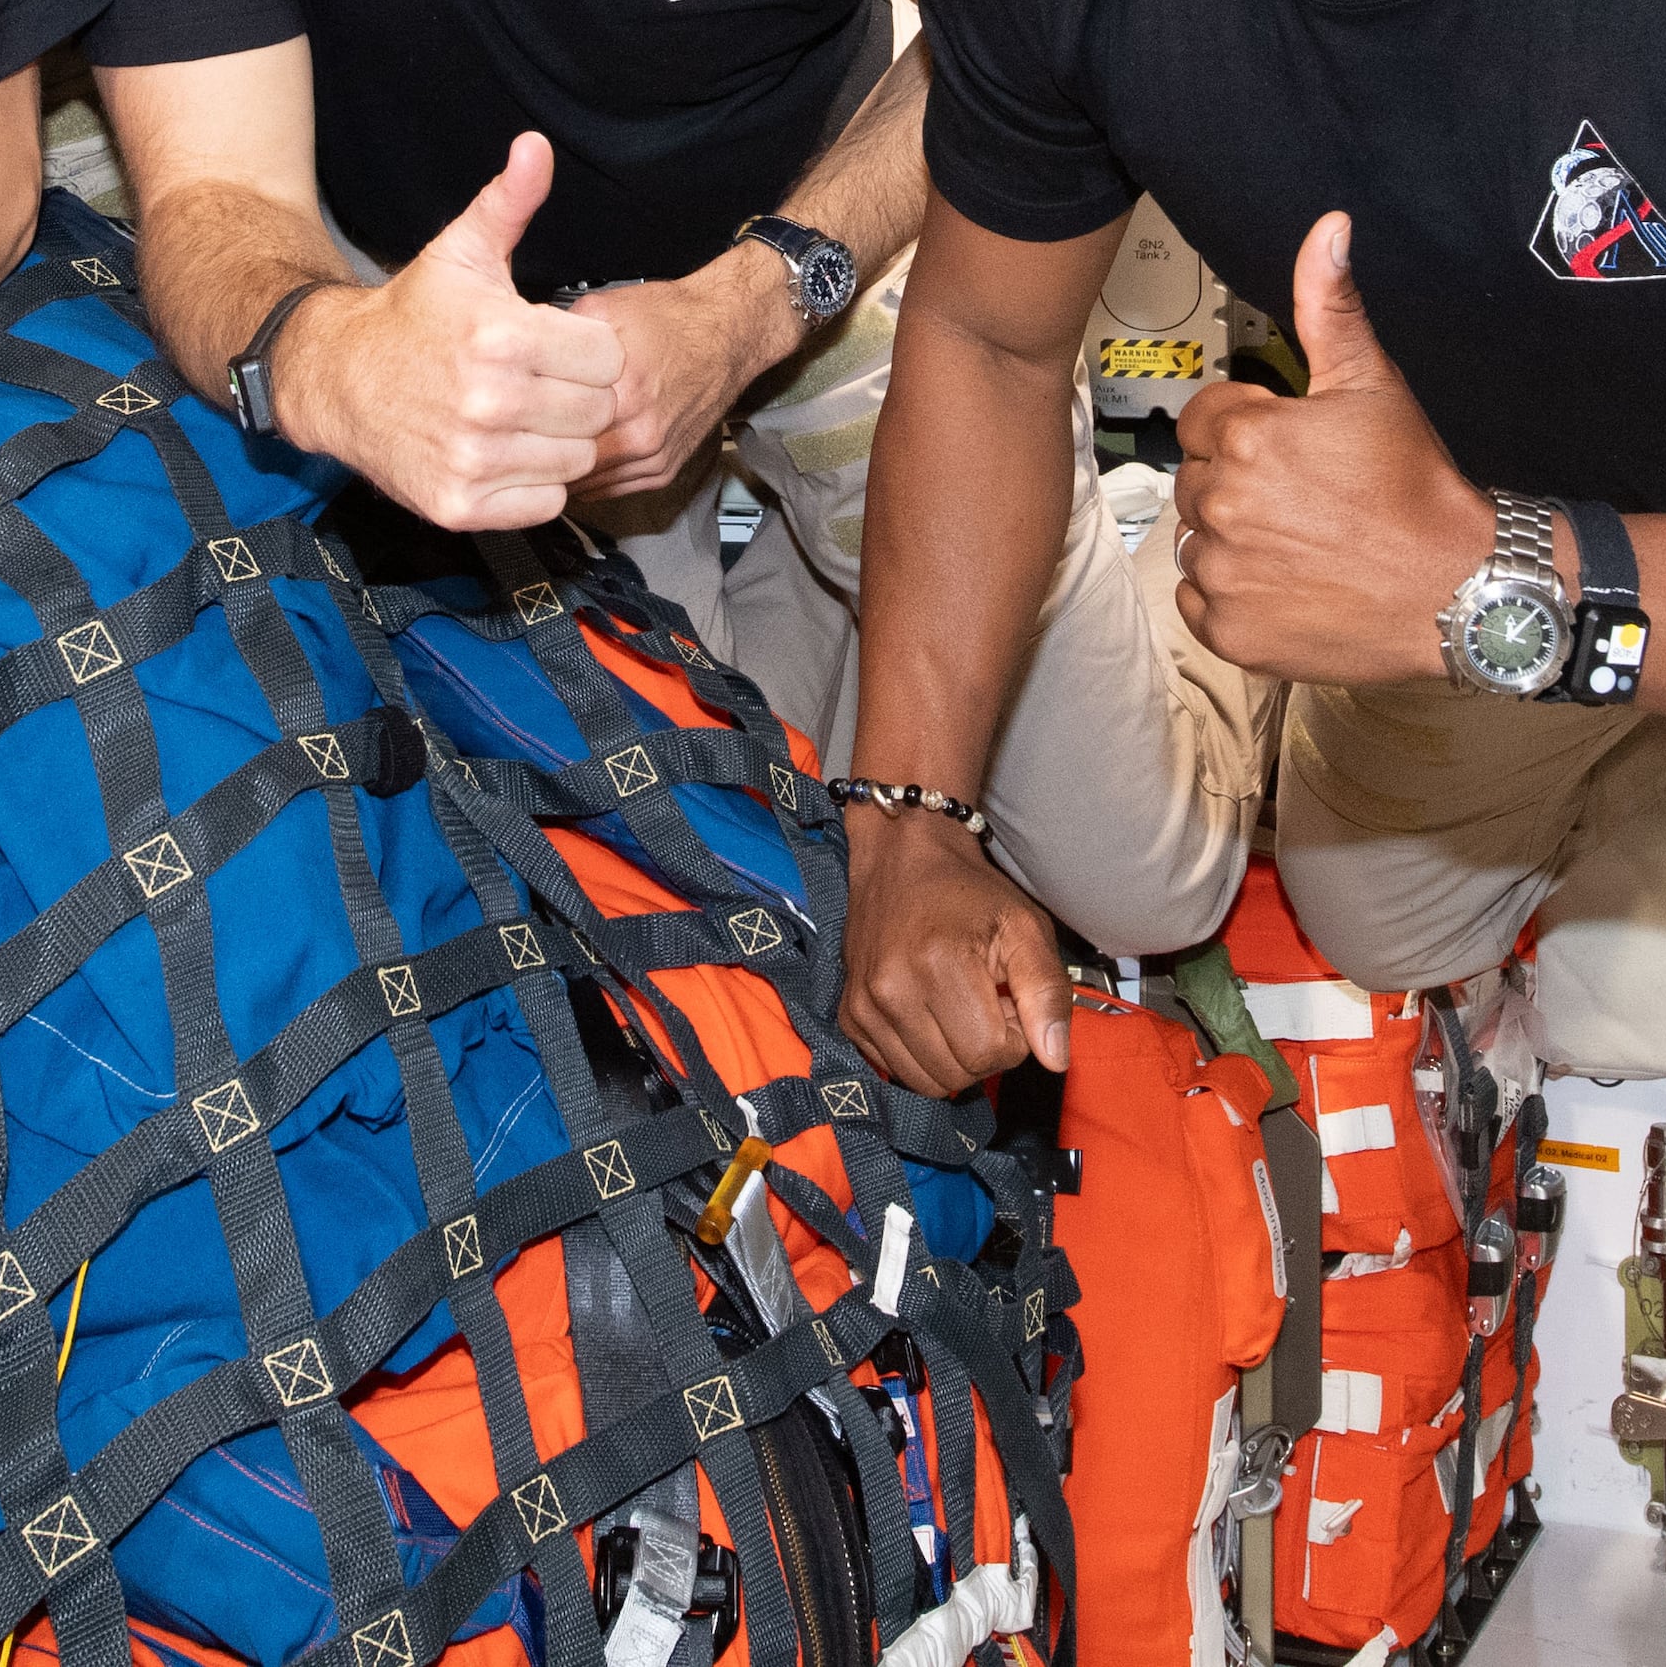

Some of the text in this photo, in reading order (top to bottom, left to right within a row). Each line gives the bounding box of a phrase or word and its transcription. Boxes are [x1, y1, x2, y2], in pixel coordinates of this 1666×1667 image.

[1138, 239, 1165, 251] GN2
[1134, 250, 1171, 261] Tank 2
[1113, 348, 1160, 359] WARNING
[1561, 1150, 1594, 1160] Medical
[1252, 1167, 1283, 1242] Mooring
